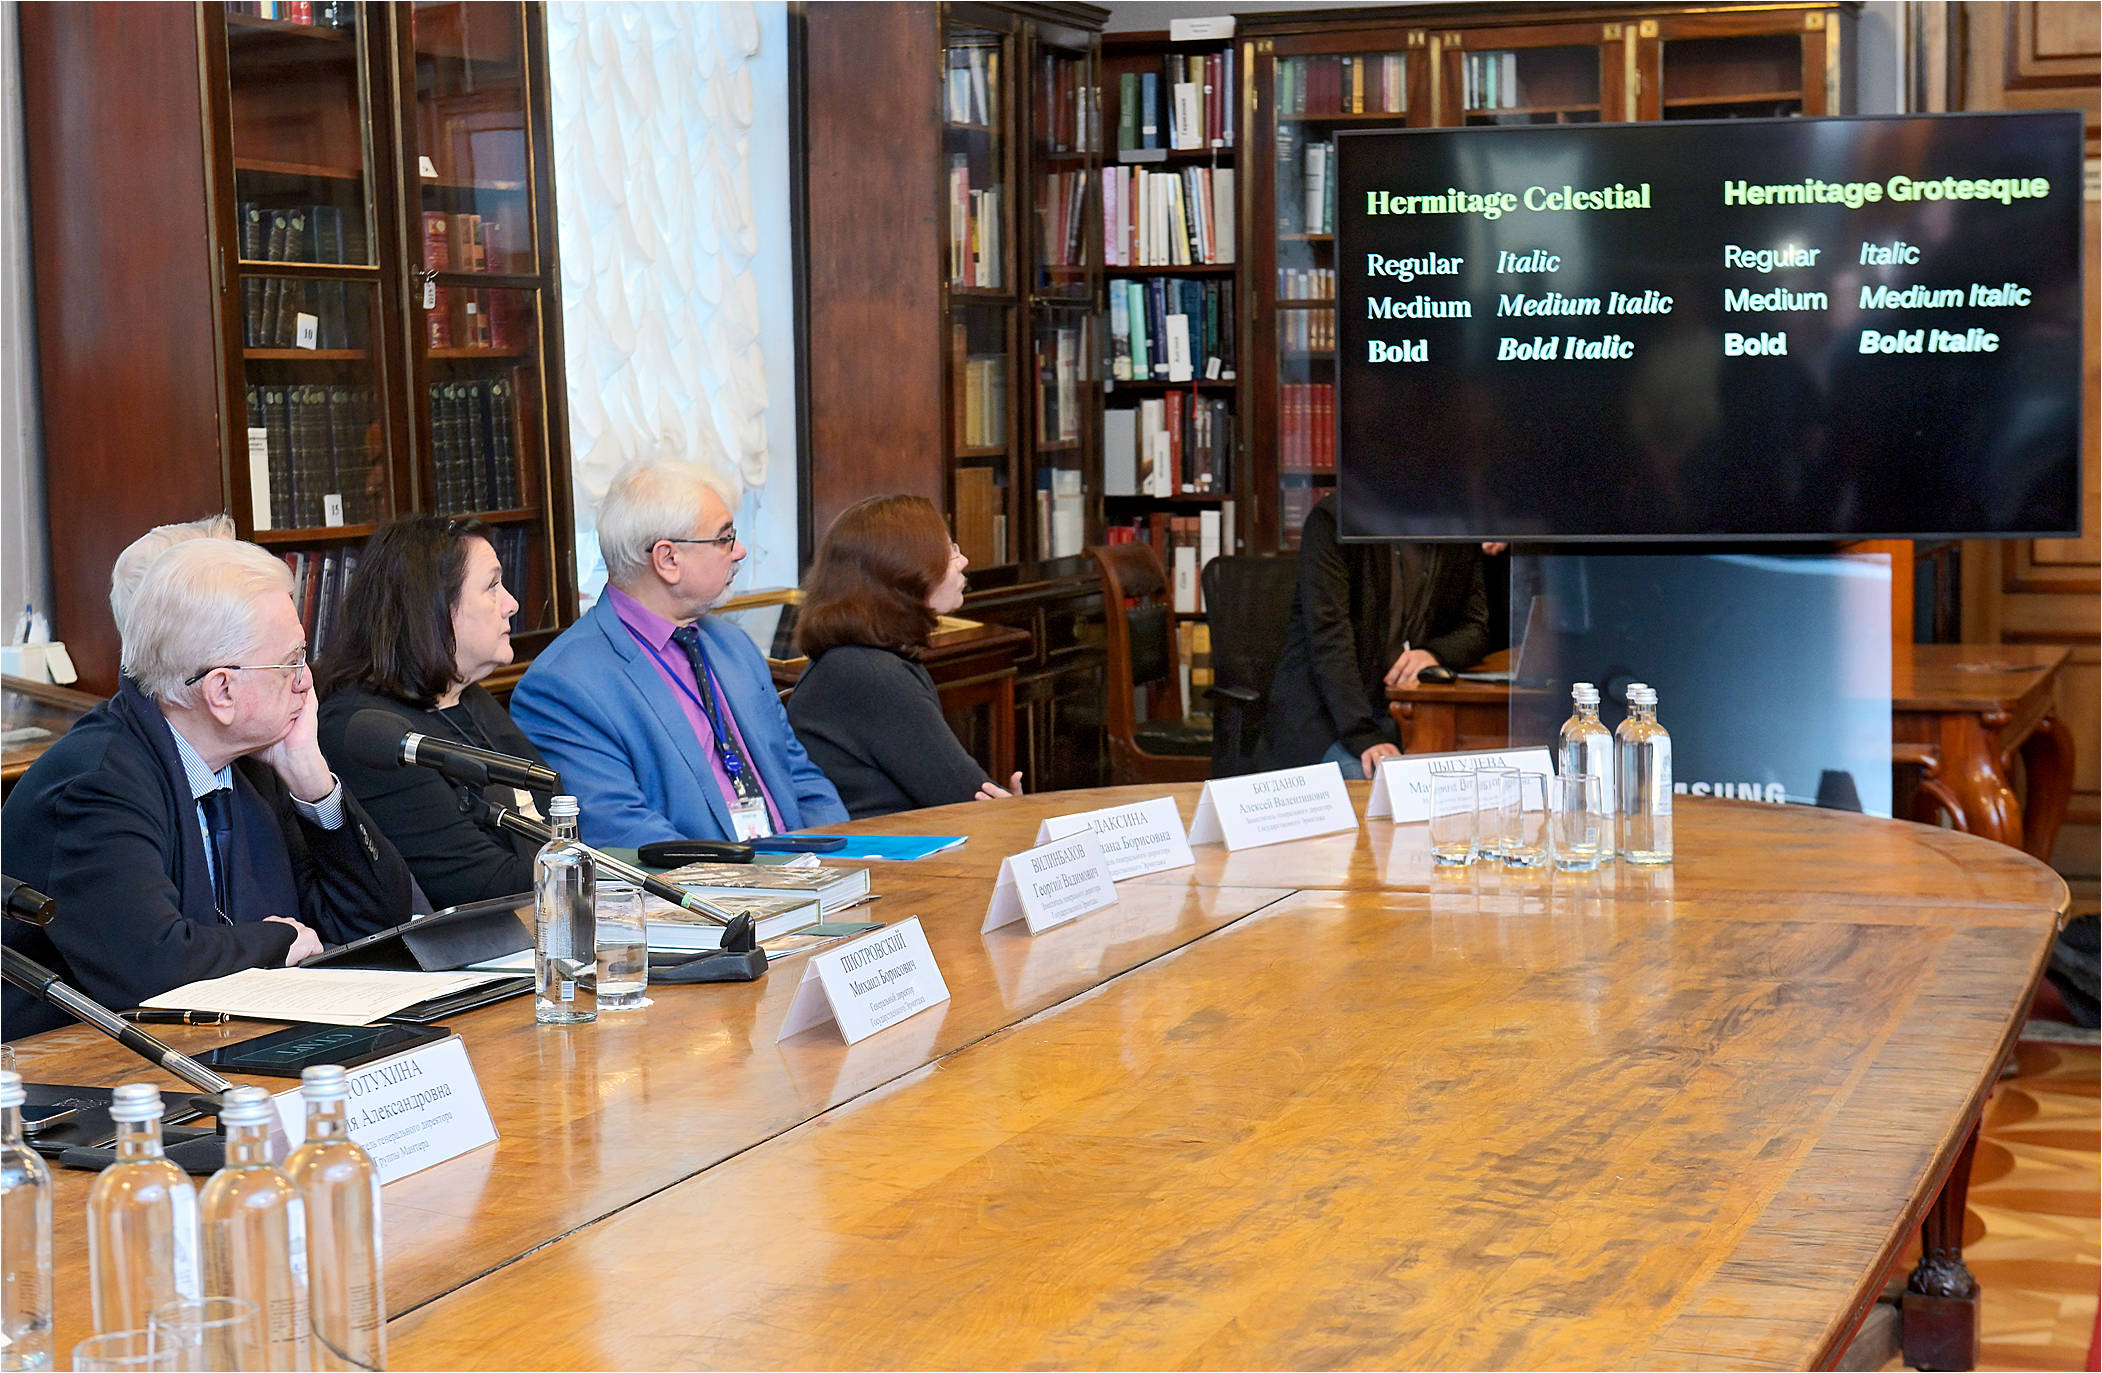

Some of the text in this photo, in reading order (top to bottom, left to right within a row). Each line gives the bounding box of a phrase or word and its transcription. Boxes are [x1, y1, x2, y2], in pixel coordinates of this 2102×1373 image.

[1366, 183, 1652, 220] Hermitage Celestial
[1724, 177, 1883, 209] Hermitage
[1886, 174, 2050, 205] Grotesque
[1496, 249, 1561, 274] Italic
[1724, 243, 1821, 274] Regular
[1859, 240, 1920, 266] Italic
[1367, 252, 1464, 282] Regular
[1367, 295, 1472, 319] Medium
[1496, 290, 1674, 317] Medium Italic
[1724, 287, 1828, 312] Medium
[1859, 282, 2032, 309] Medium Italic
[1367, 338, 1429, 363] Bold
[1497, 334, 1635, 361] Bold Italic
[1724, 331, 1788, 357] Bold
[1859, 328, 2000, 355] Bold Italic
[331, 503, 340, 516] 15
[1252, 775, 1307, 795] БОГДАНОВ
[1239, 790, 1330, 814] Алексей Валентинович
[1121, 831, 1171, 851] Борисовна
[1031, 844, 1086, 874] ВИЛИНБАХОВ
[1032, 875, 1064, 898] Георгий
[1061, 867, 1100, 888] Вадимович
[840, 929, 907, 974] ПИОТРОВСКИЙ
[849, 960, 917, 998] Михаил Борисович
[361, 1083, 452, 1127] Александровна
